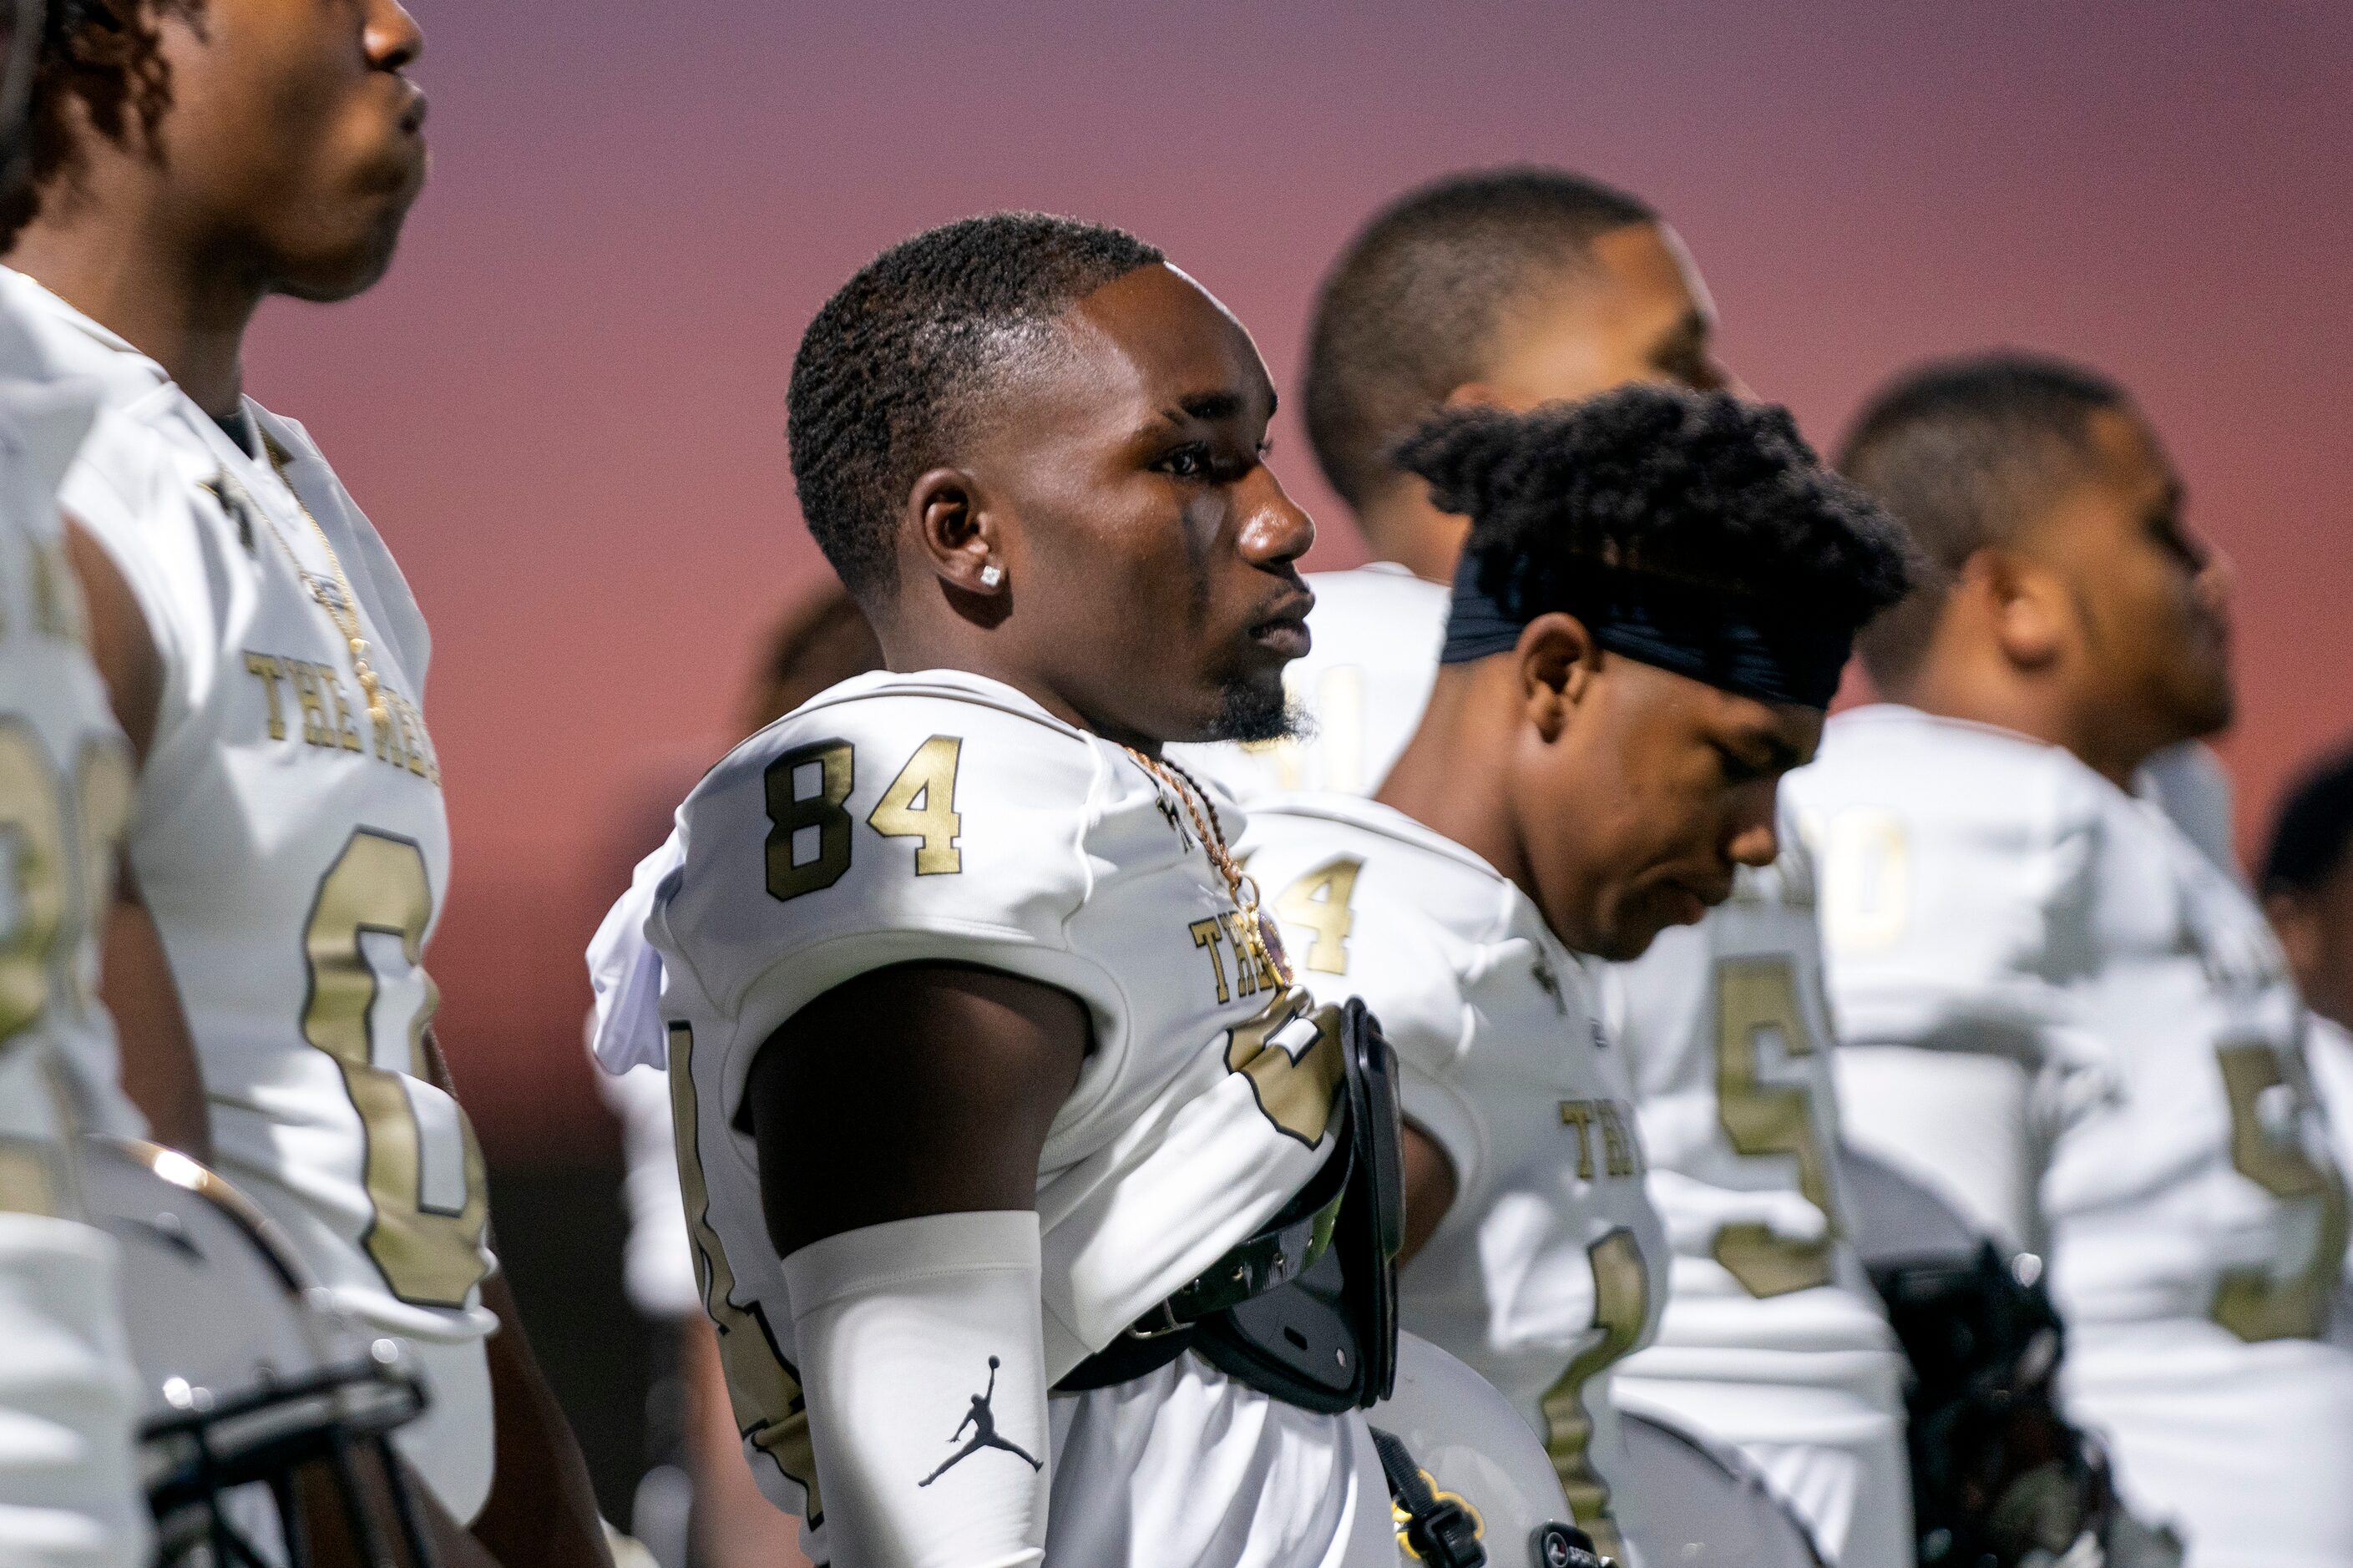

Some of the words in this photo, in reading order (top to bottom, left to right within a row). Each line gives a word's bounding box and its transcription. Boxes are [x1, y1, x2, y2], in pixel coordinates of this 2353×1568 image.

[241, 649, 364, 753] THE
[764, 735, 964, 902] 84
[1797, 803, 1912, 950] 0
[1236, 845, 1369, 976] 4
[1558, 1098, 1643, 1181] TH
[1714, 950, 1834, 1298] 5
[2211, 1039, 2350, 1344] 5
